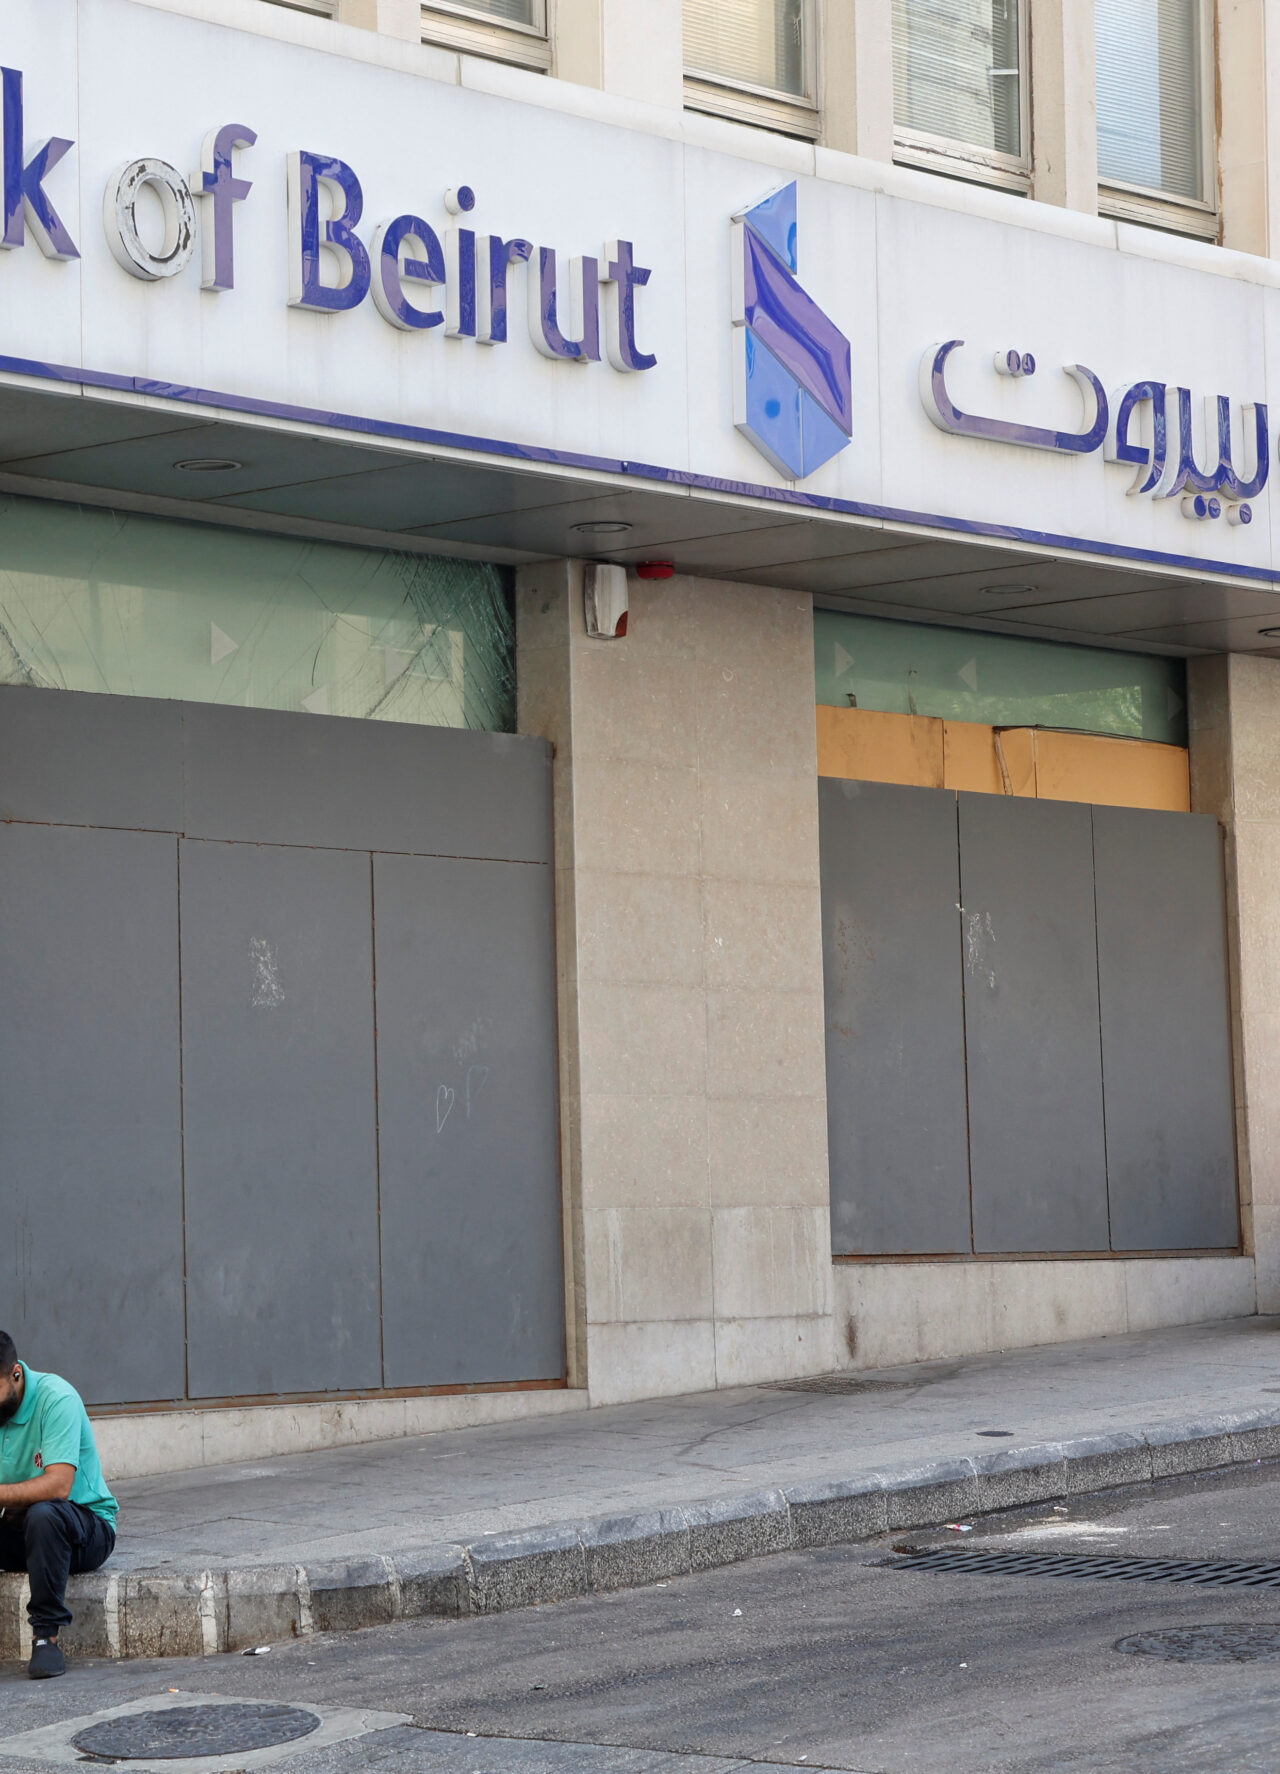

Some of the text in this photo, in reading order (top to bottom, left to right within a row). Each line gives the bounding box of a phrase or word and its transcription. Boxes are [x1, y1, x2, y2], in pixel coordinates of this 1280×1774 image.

[104, 123, 258, 293] of
[287, 149, 657, 374] Beirut
[921, 340, 1270, 526] بيروت
